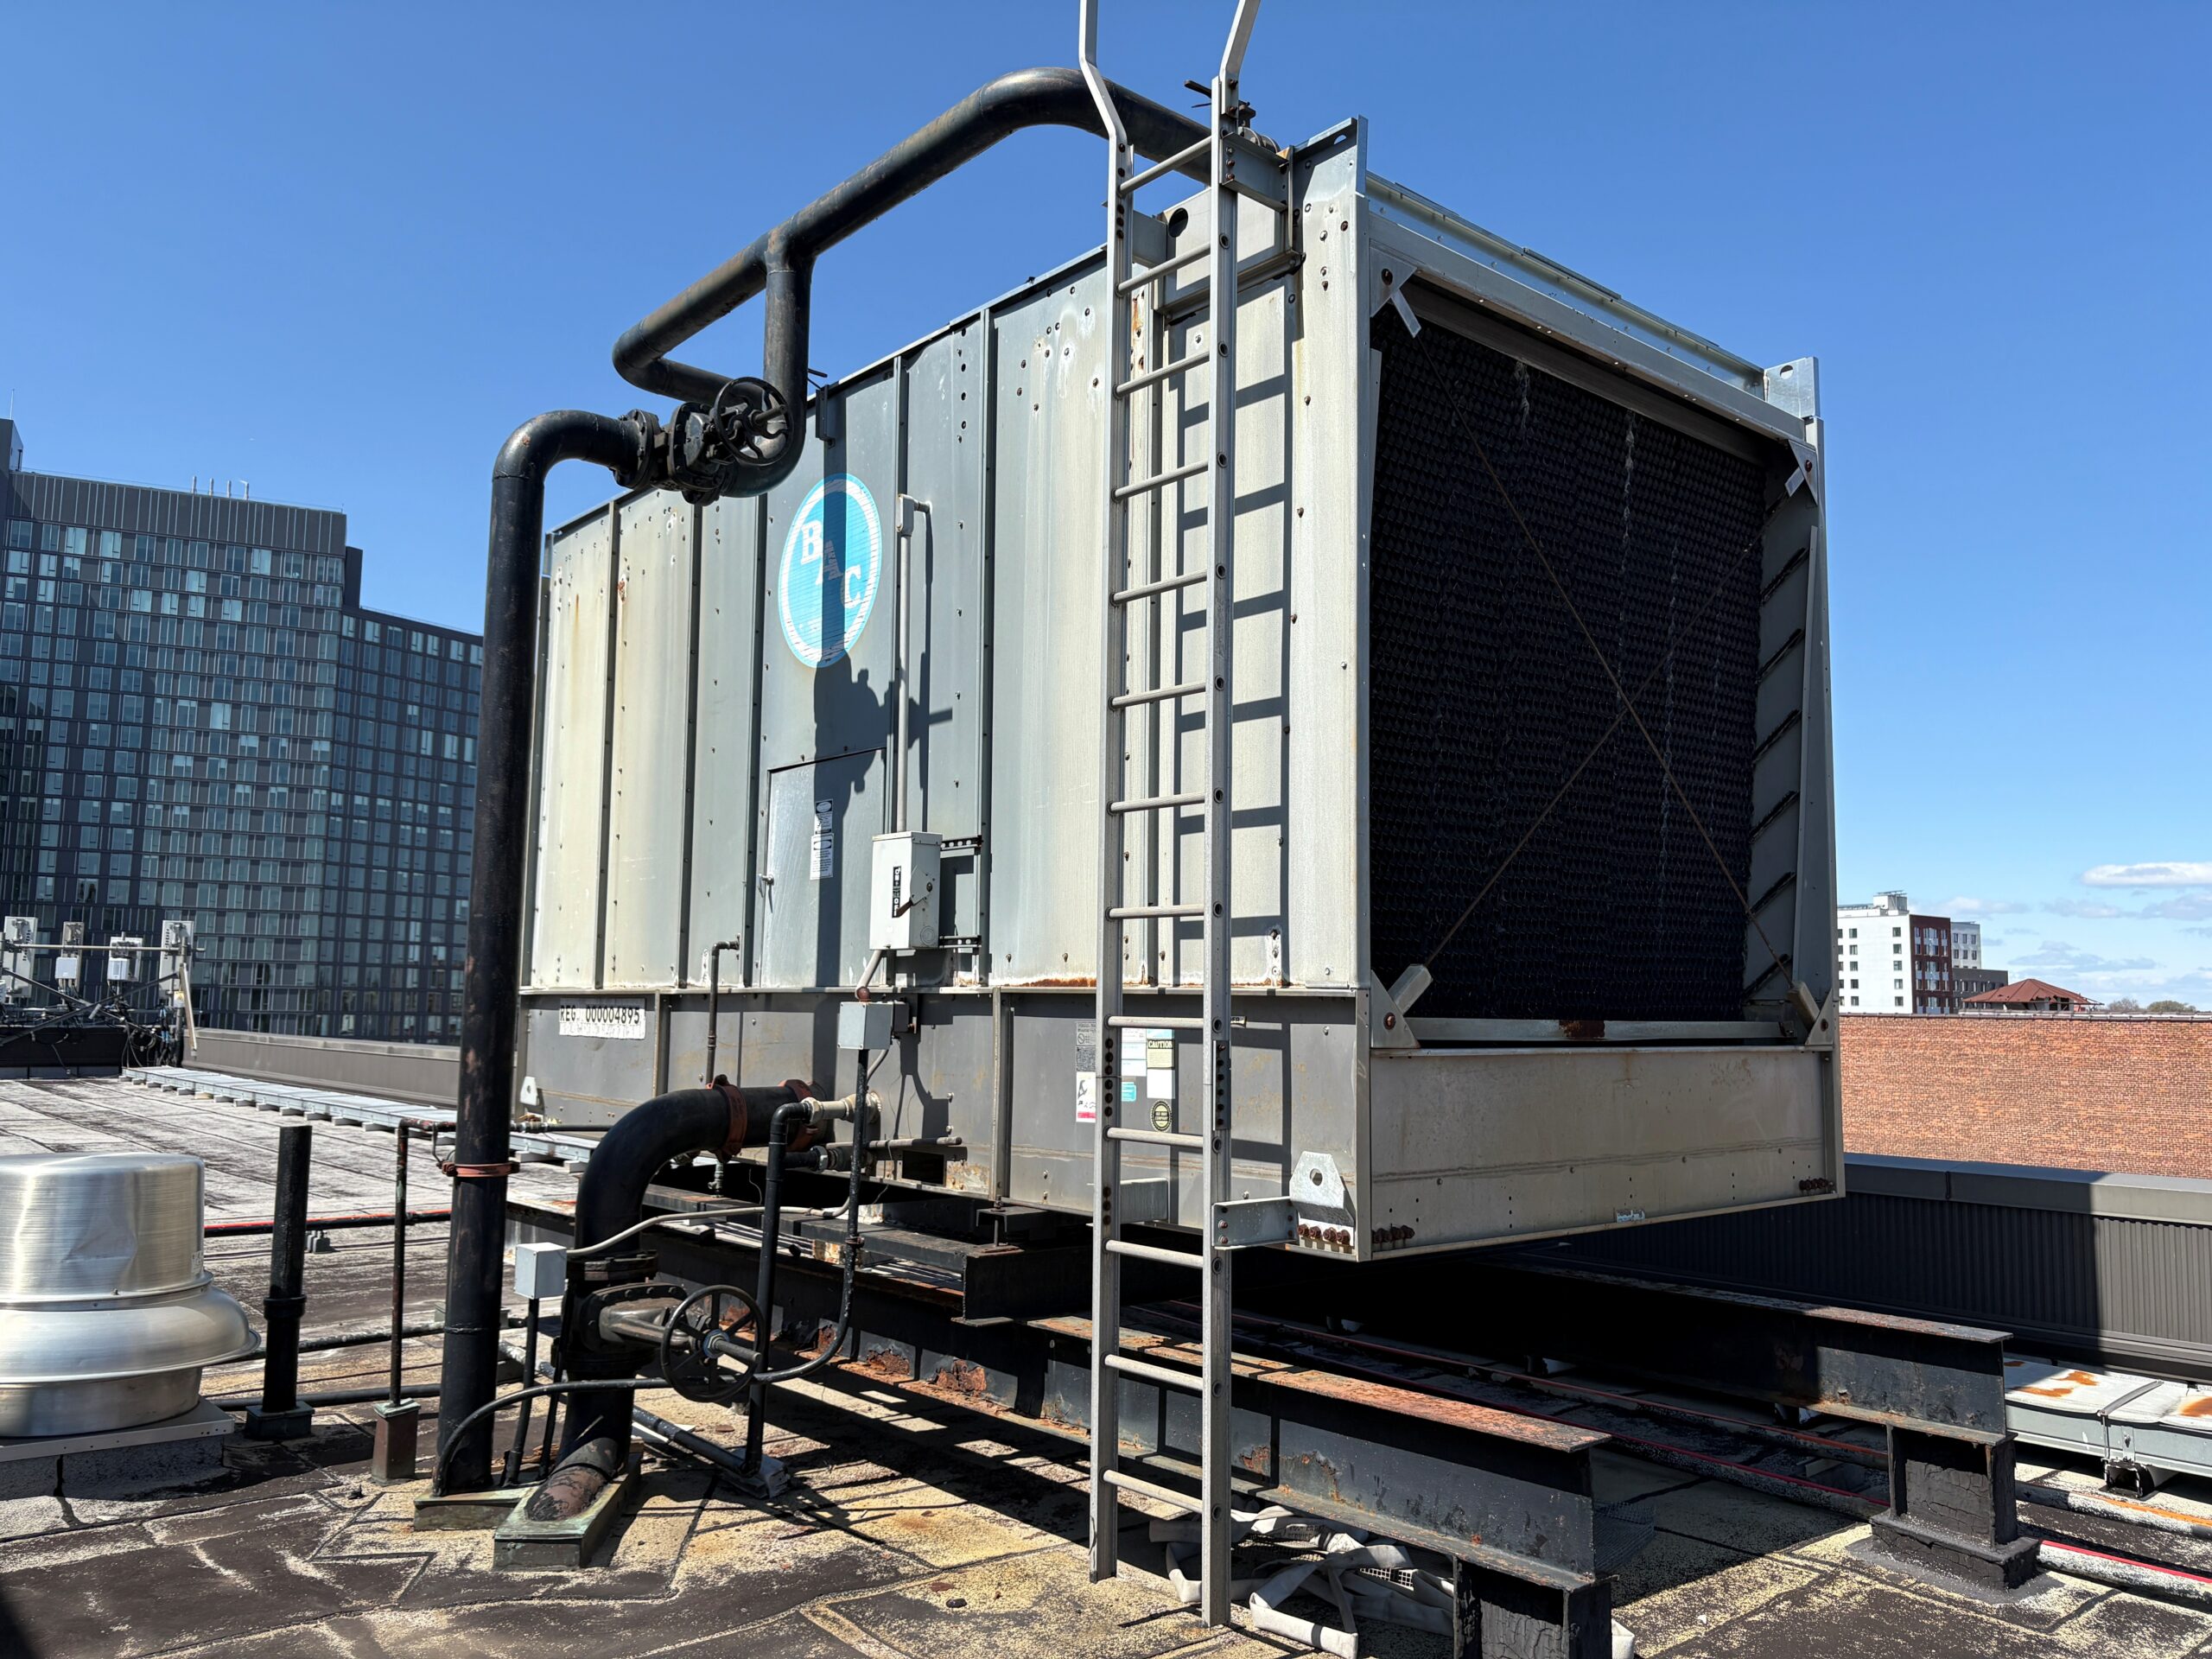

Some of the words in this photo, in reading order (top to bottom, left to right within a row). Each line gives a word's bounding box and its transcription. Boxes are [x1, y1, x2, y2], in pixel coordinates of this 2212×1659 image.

[800, 518, 863, 609] BAC
[586, 1005, 640, 1025] 000004895
[1148, 1039, 1173, 1049] CAUTION
